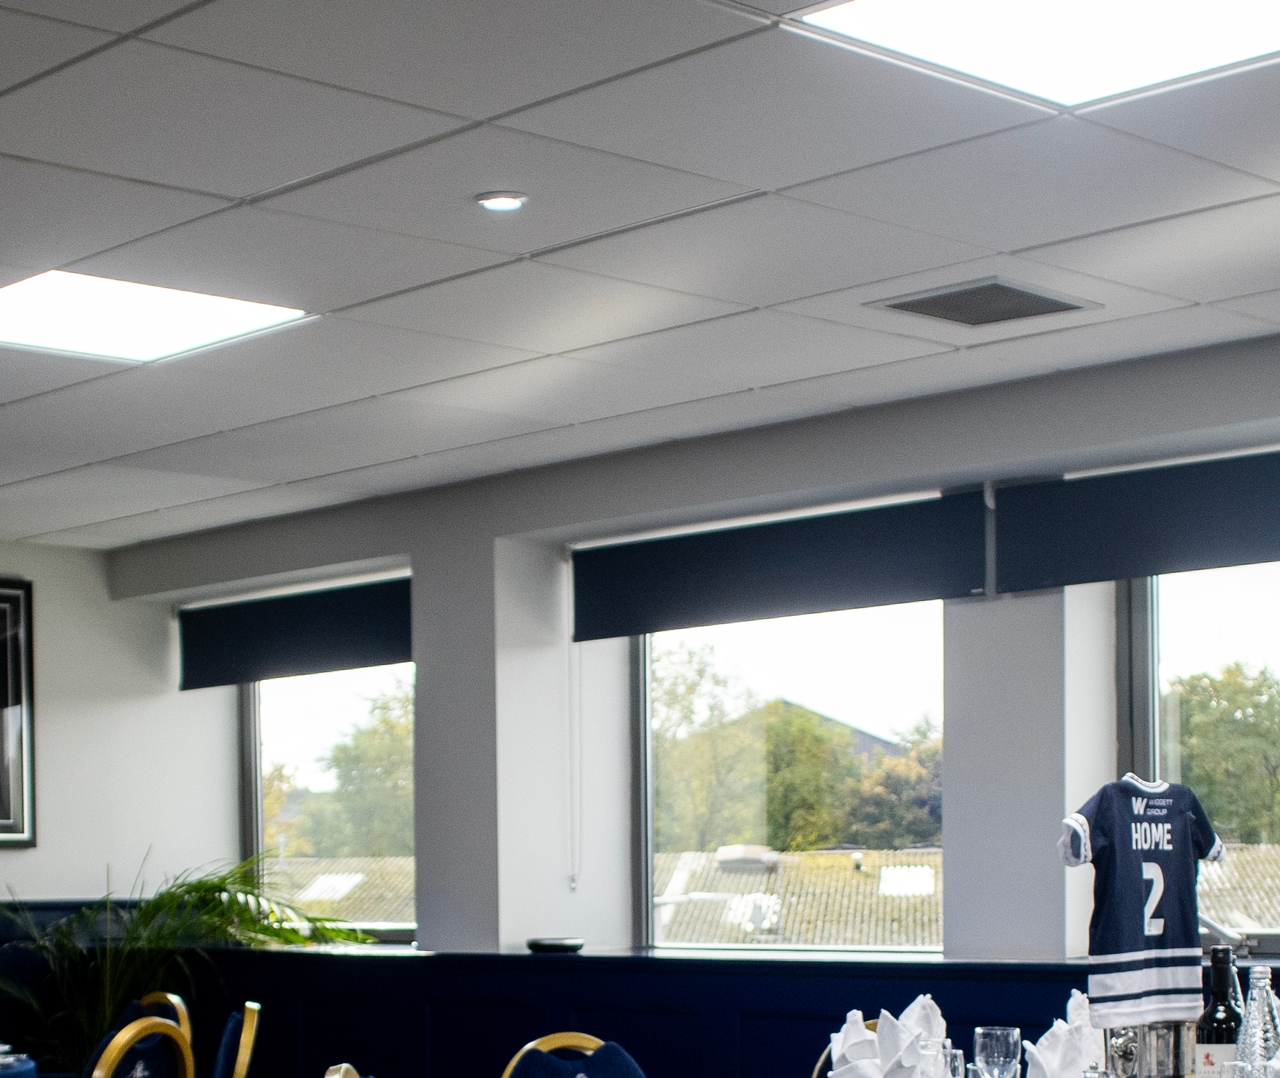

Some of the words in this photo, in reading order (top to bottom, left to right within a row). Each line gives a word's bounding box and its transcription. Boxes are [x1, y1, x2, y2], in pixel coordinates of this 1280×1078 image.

[1131, 796, 1148, 815] W
[1147, 808, 1168, 816] GROUP
[1131, 821, 1173, 850] HOME
[1142, 862, 1165, 936] 2
